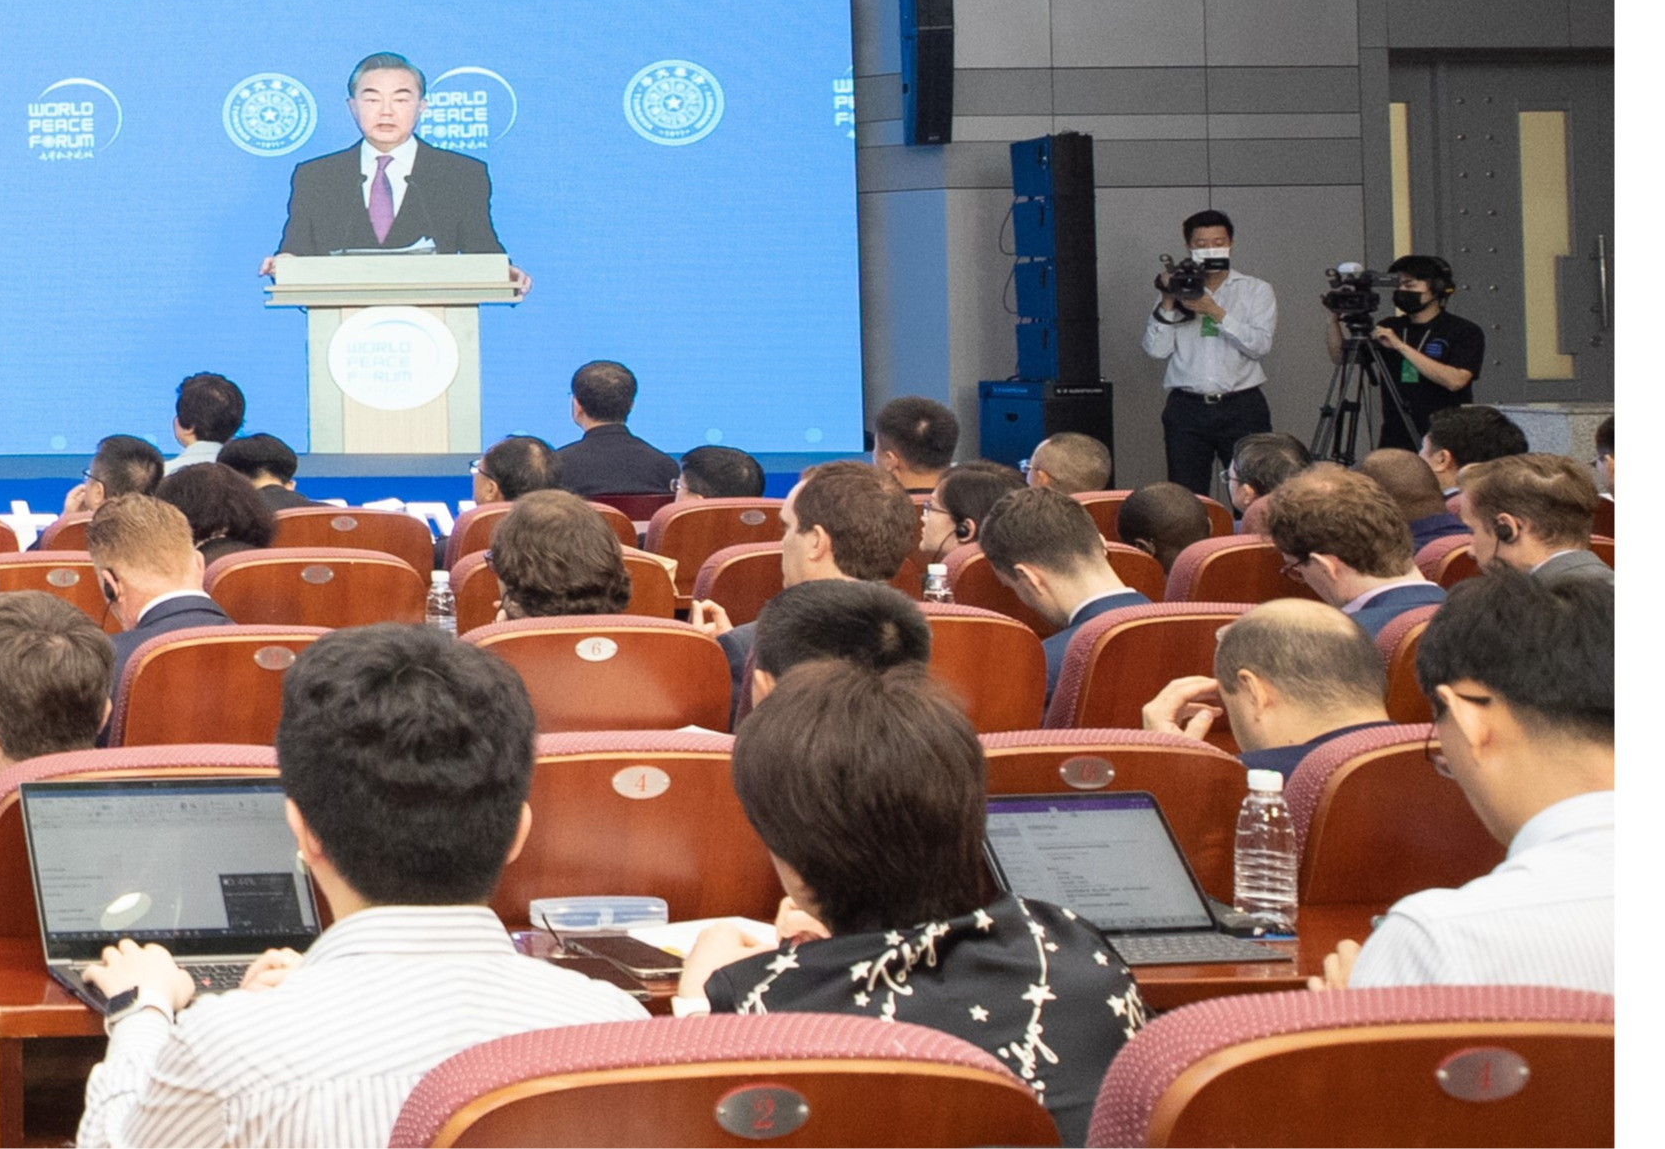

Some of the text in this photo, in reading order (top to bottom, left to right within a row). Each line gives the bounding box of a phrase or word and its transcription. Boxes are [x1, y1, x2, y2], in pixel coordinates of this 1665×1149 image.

[27, 101, 94, 117] WORLD
[420, 106, 488, 123] PEACE
[28, 117, 95, 133] PEACE
[347, 370, 413, 383] FRUM
[590, 641, 602, 656] 6
[634, 772, 646, 792] 4
[752, 1095, 776, 1132] 2
